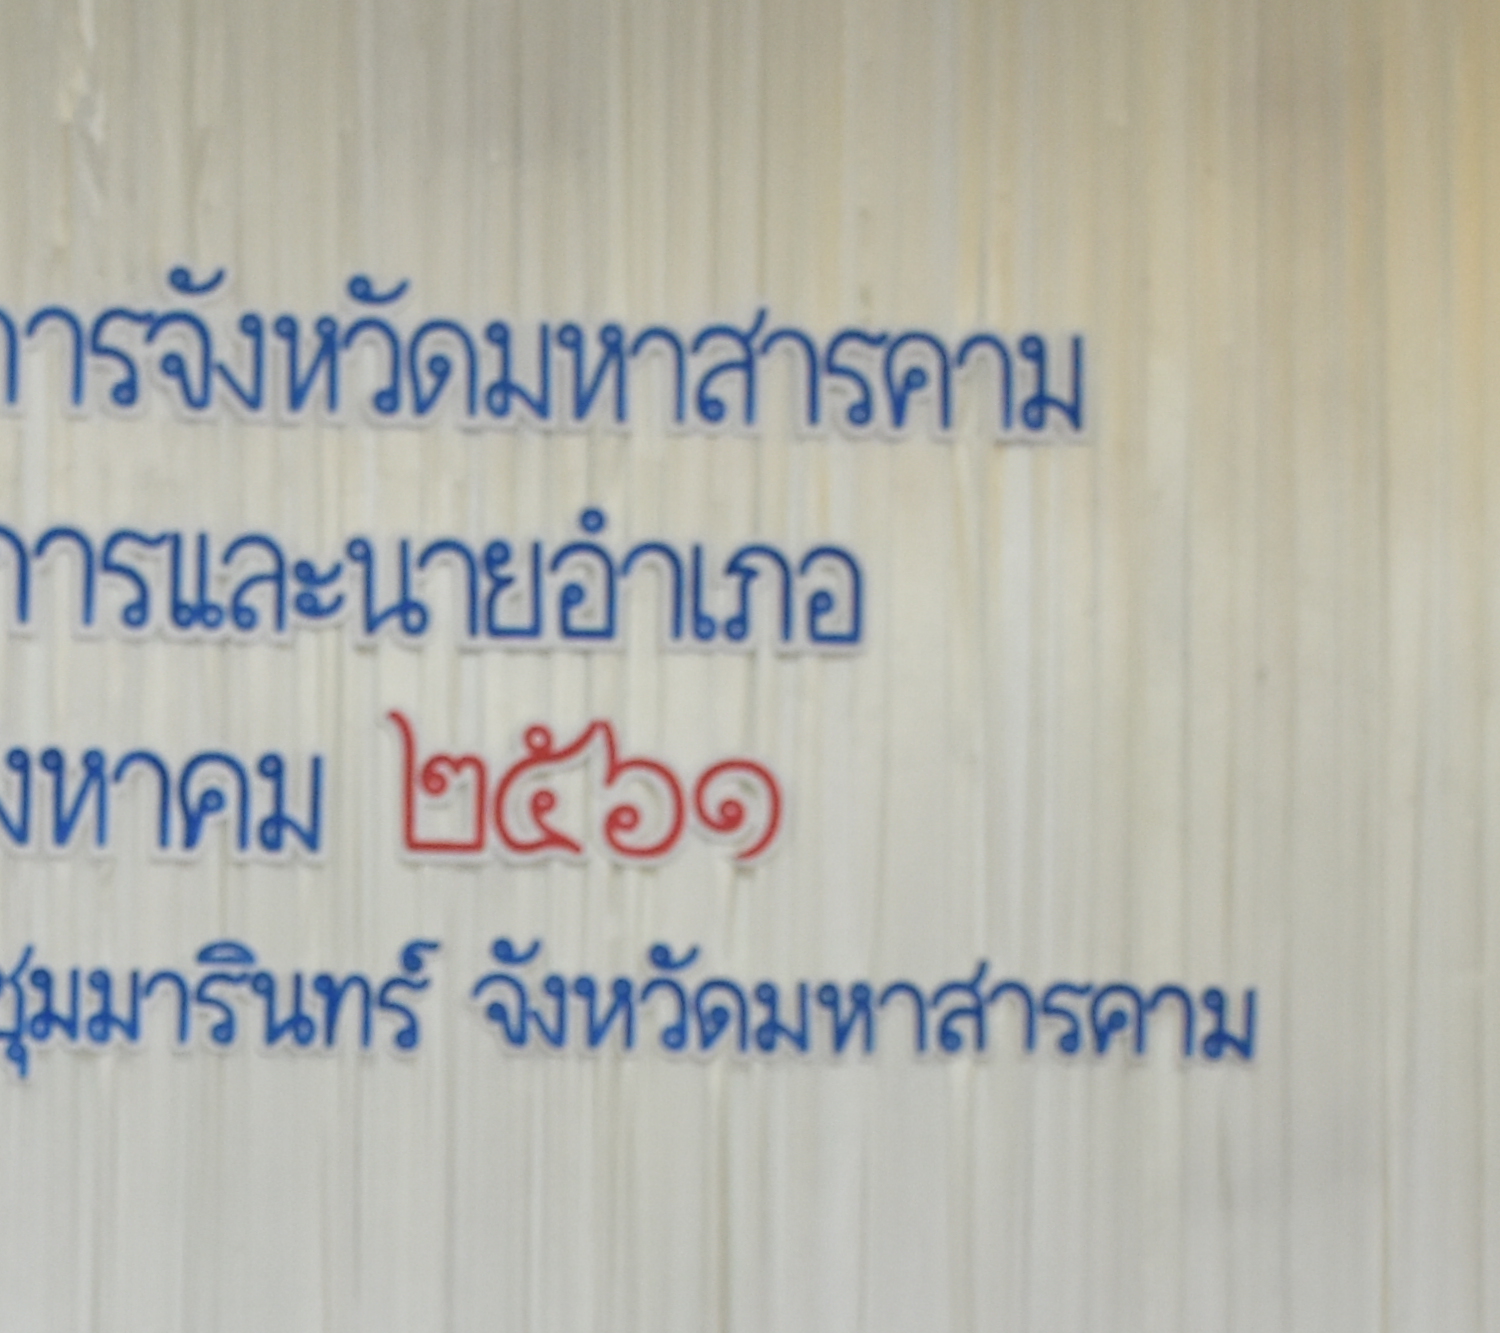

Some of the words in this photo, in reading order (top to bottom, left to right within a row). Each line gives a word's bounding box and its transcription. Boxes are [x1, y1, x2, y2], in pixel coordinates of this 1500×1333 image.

[389, 710, 783, 859] ๒๕๖๑
[472, 937, 1258, 1060] จังหวัดมหาสารคาม
